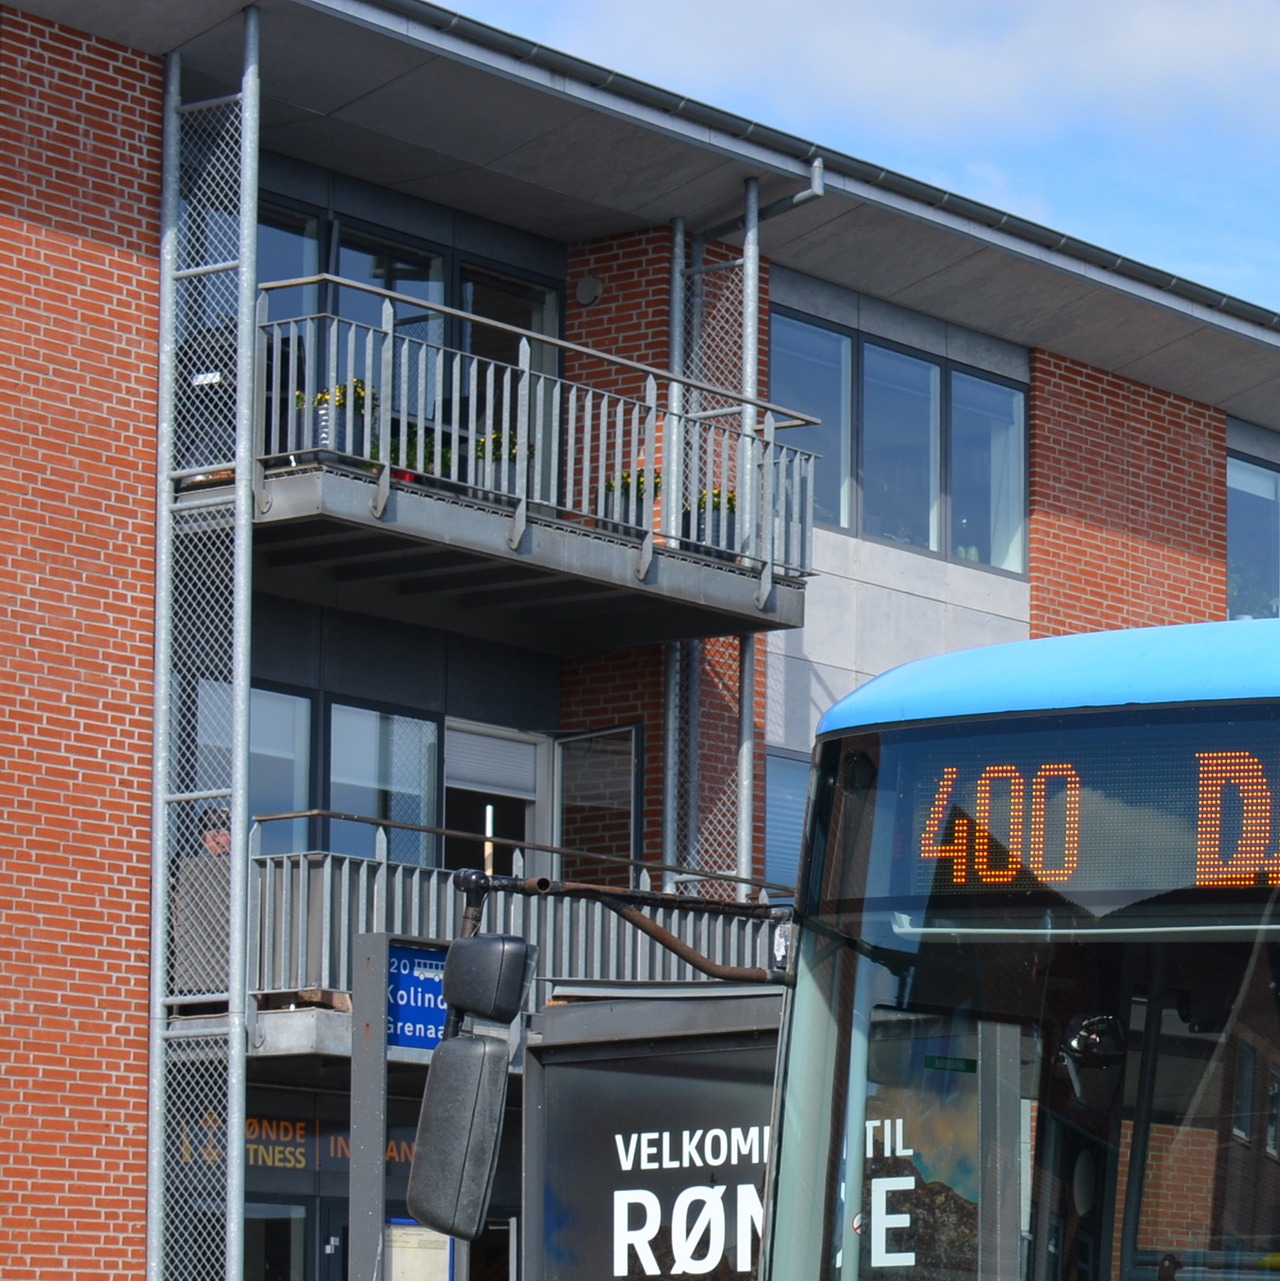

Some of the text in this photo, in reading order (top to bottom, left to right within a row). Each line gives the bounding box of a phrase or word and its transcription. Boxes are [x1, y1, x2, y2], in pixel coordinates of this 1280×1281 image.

[920, 764, 1080, 883] 400
[245, 1118, 306, 1143] ØNDE
[865, 1118, 914, 1158] TIL
[245, 1144, 306, 1169] TNESS
